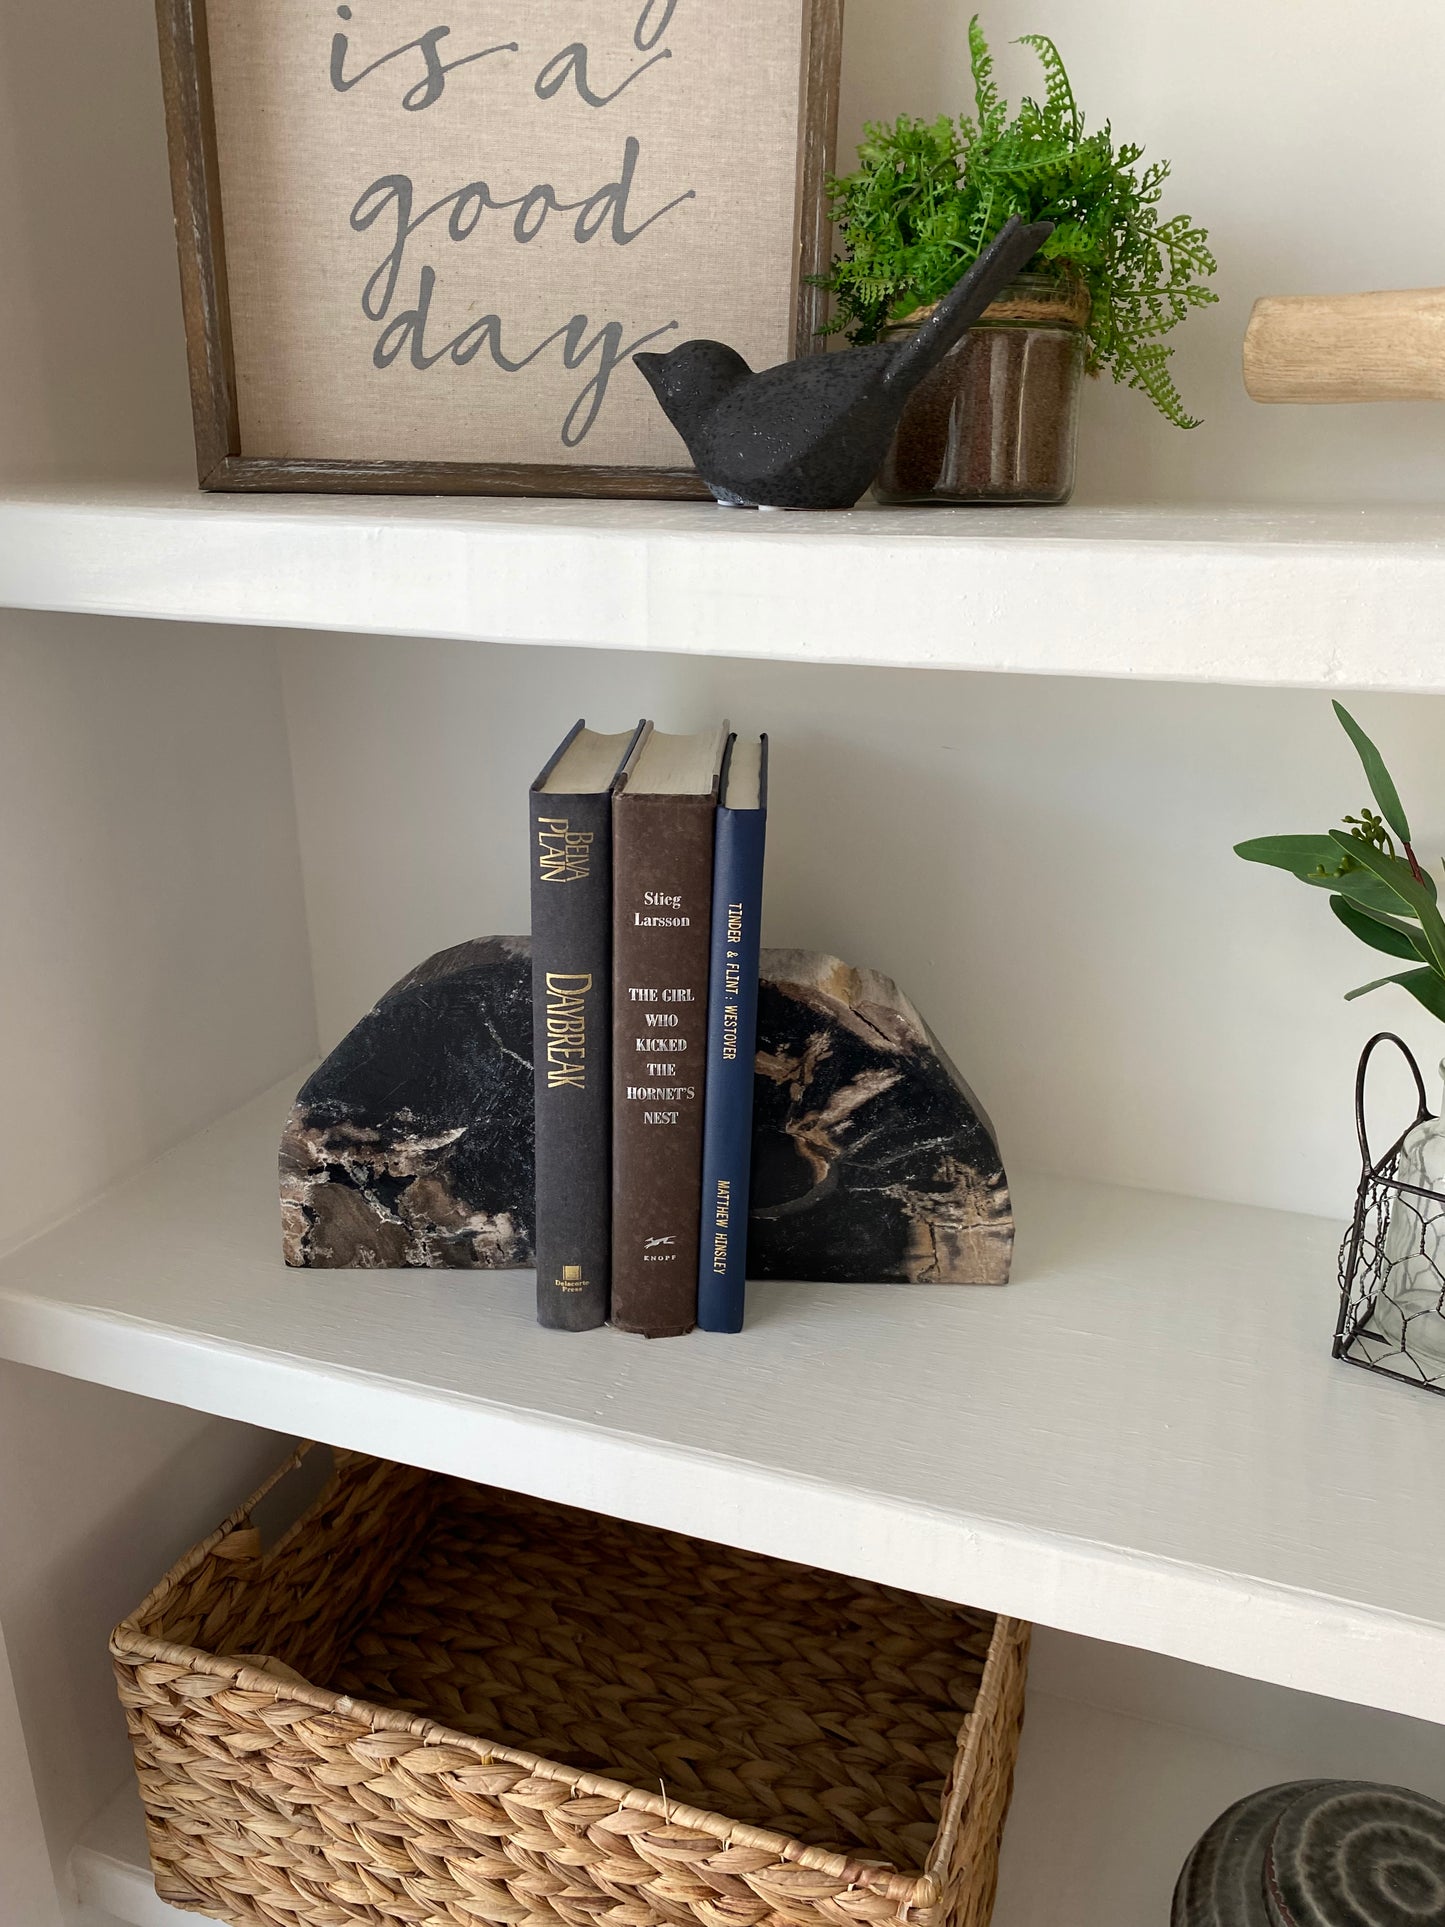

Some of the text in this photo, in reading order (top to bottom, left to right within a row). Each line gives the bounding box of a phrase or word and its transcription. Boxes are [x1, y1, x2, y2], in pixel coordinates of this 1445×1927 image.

[330, 5, 672, 111] is a
[350, 137, 696, 321] good
[373, 266, 679, 447] day
[538, 816, 568, 883] PLAIN
[565, 832, 594, 882] BELVA
[634, 912, 690, 927] Larsson
[644, 891, 682, 909] Stieg
[727, 903, 742, 943] TINDER
[629, 988, 695, 1002] THE GIRL
[545, 972, 593, 1089] DAYBREAK
[645, 1013, 679, 1027] WHO
[723, 1005, 738, 1060] WESTOVER
[635, 1038, 687, 1052] KICKED
[647, 1063, 676, 1076] THE
[626, 1086, 695, 1100] HORNET'S
[643, 1112, 679, 1124] NEST
[713, 1180, 730, 1275] MATTHEW HINSLEY
